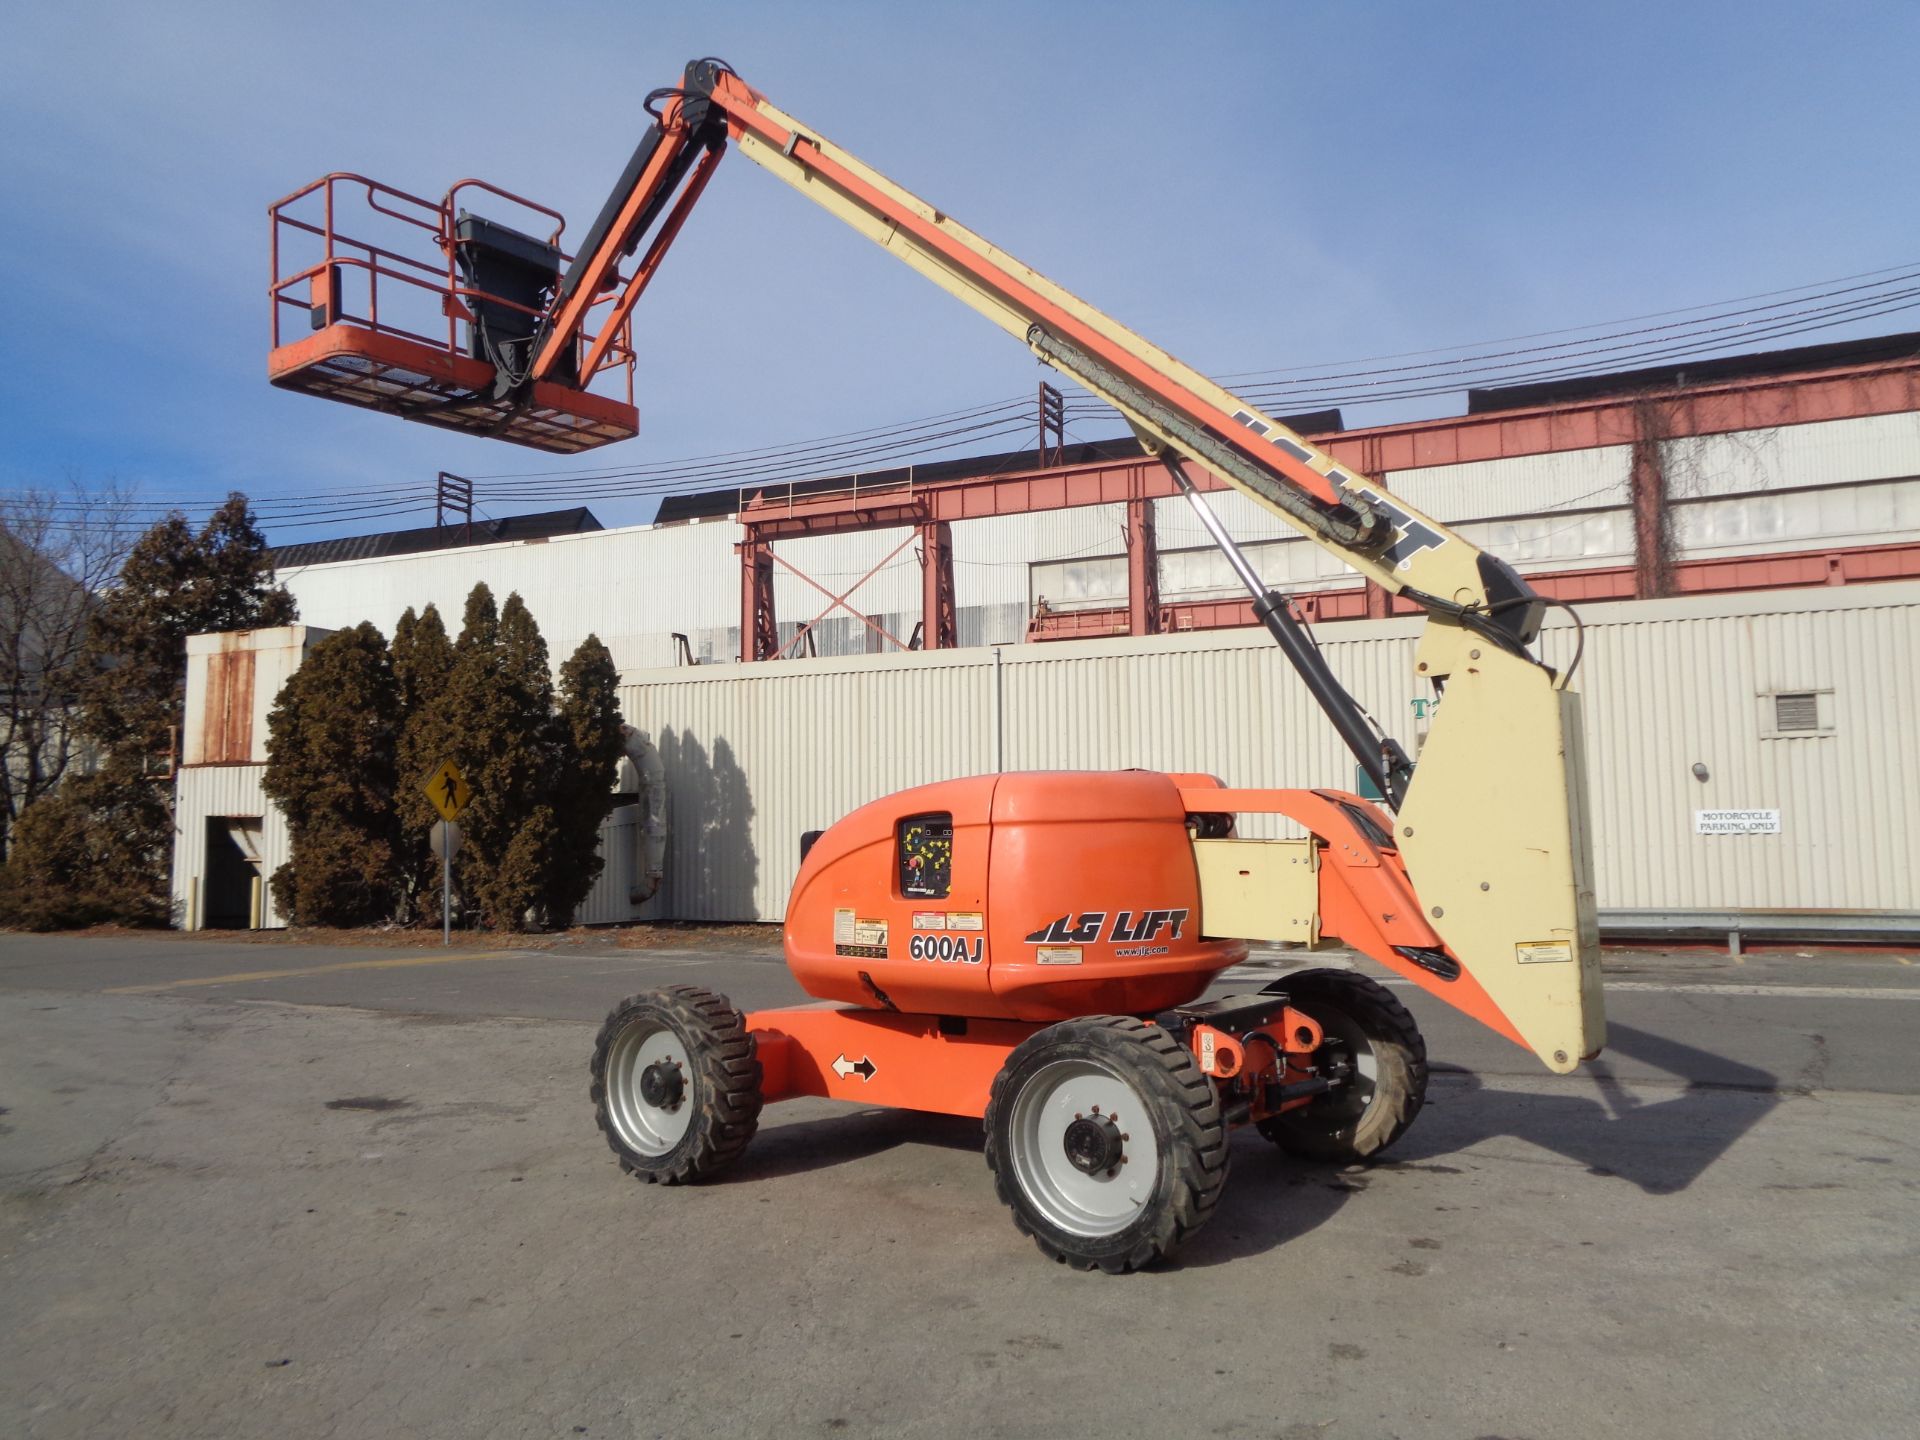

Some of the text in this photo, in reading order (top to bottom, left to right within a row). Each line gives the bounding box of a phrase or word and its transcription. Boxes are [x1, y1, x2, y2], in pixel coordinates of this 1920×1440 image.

[1703, 812, 1772, 820] MOTORCYCLE
[1700, 822, 1776, 831] PARKING ONLY
[1024, 908, 1189, 944] JLG LIFT
[909, 934, 984, 964] 600AJ
[1116, 945, 1169, 958] www.jlg.com
